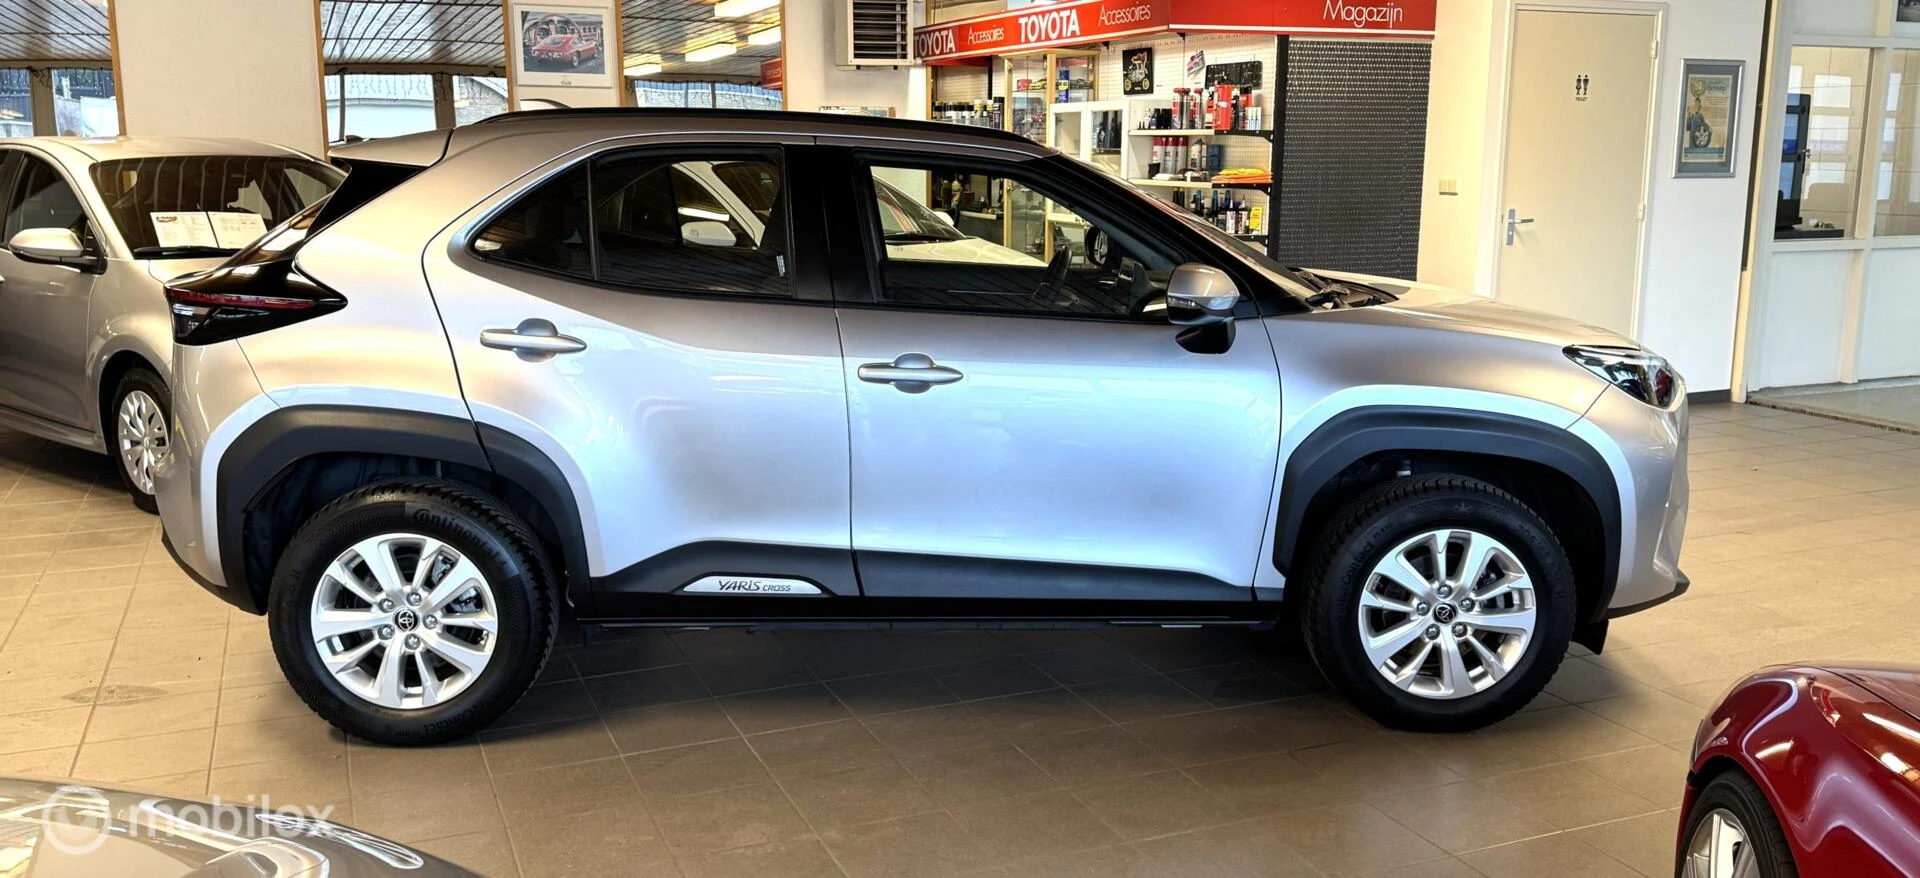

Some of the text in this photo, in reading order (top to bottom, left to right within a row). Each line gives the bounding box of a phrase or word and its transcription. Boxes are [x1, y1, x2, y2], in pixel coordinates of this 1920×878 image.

[913, 1, 1151, 57] TOYOTA Accessoires TOYOTA Accessoires
[1323, 0, 1404, 29] Magazijn
[718, 579, 791, 592] YARIS CROSS
